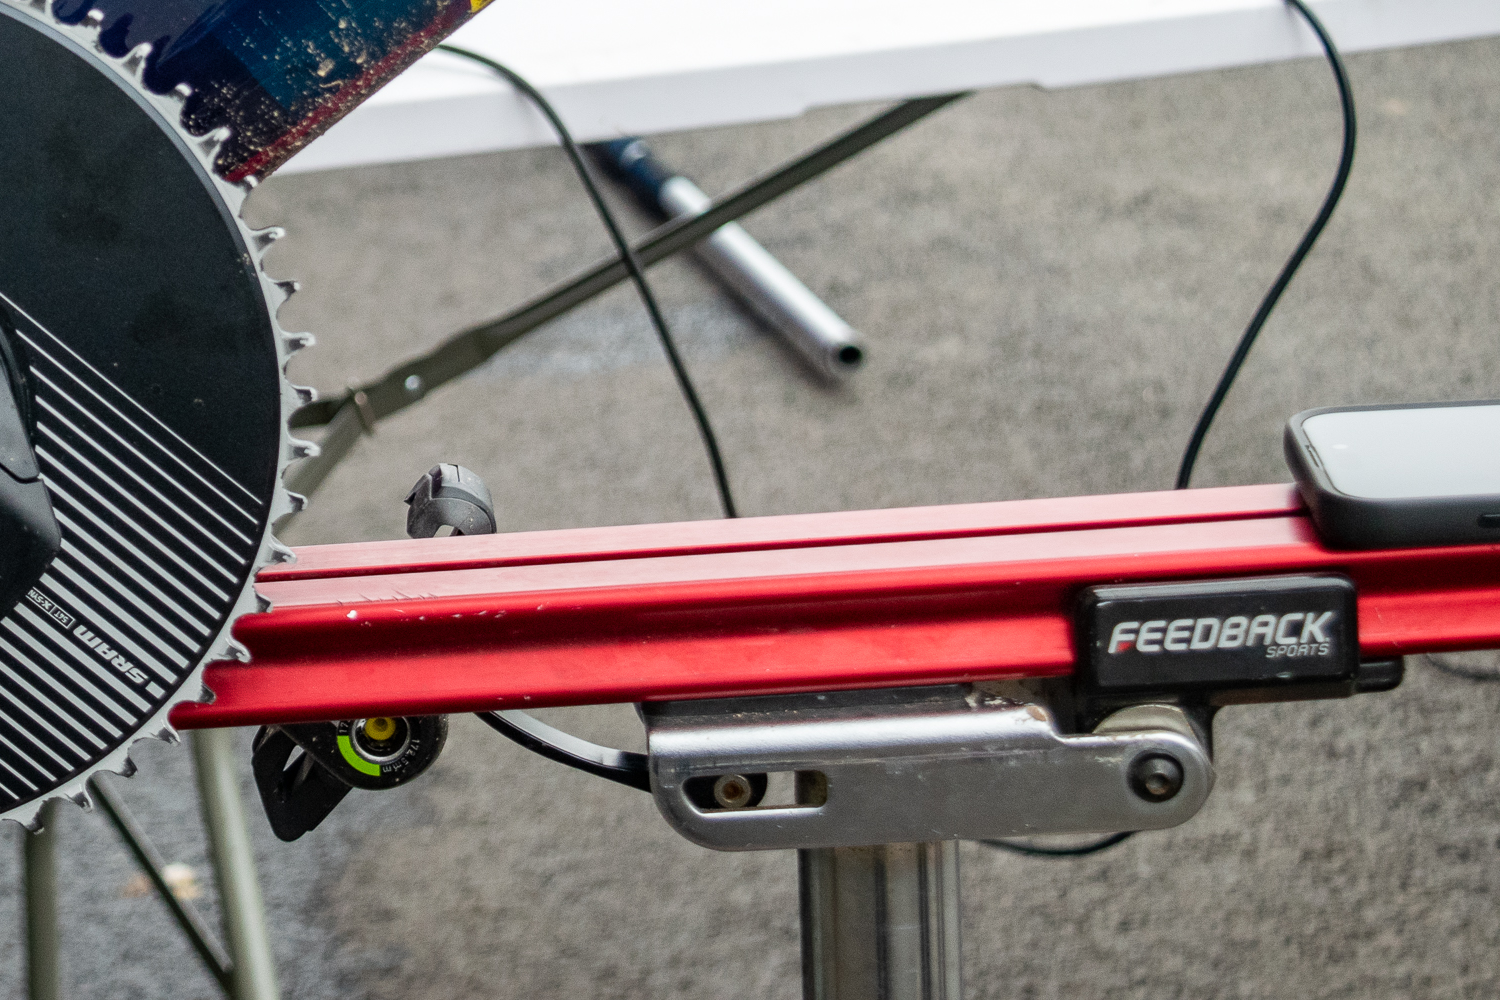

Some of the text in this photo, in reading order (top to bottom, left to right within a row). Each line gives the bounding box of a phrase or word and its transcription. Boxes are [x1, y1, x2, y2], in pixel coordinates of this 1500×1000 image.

[72, 623, 160, 685] SRAM
[1107, 610, 1332, 654] FEEDBACK
[1265, 642, 1330, 659] SPORTS
